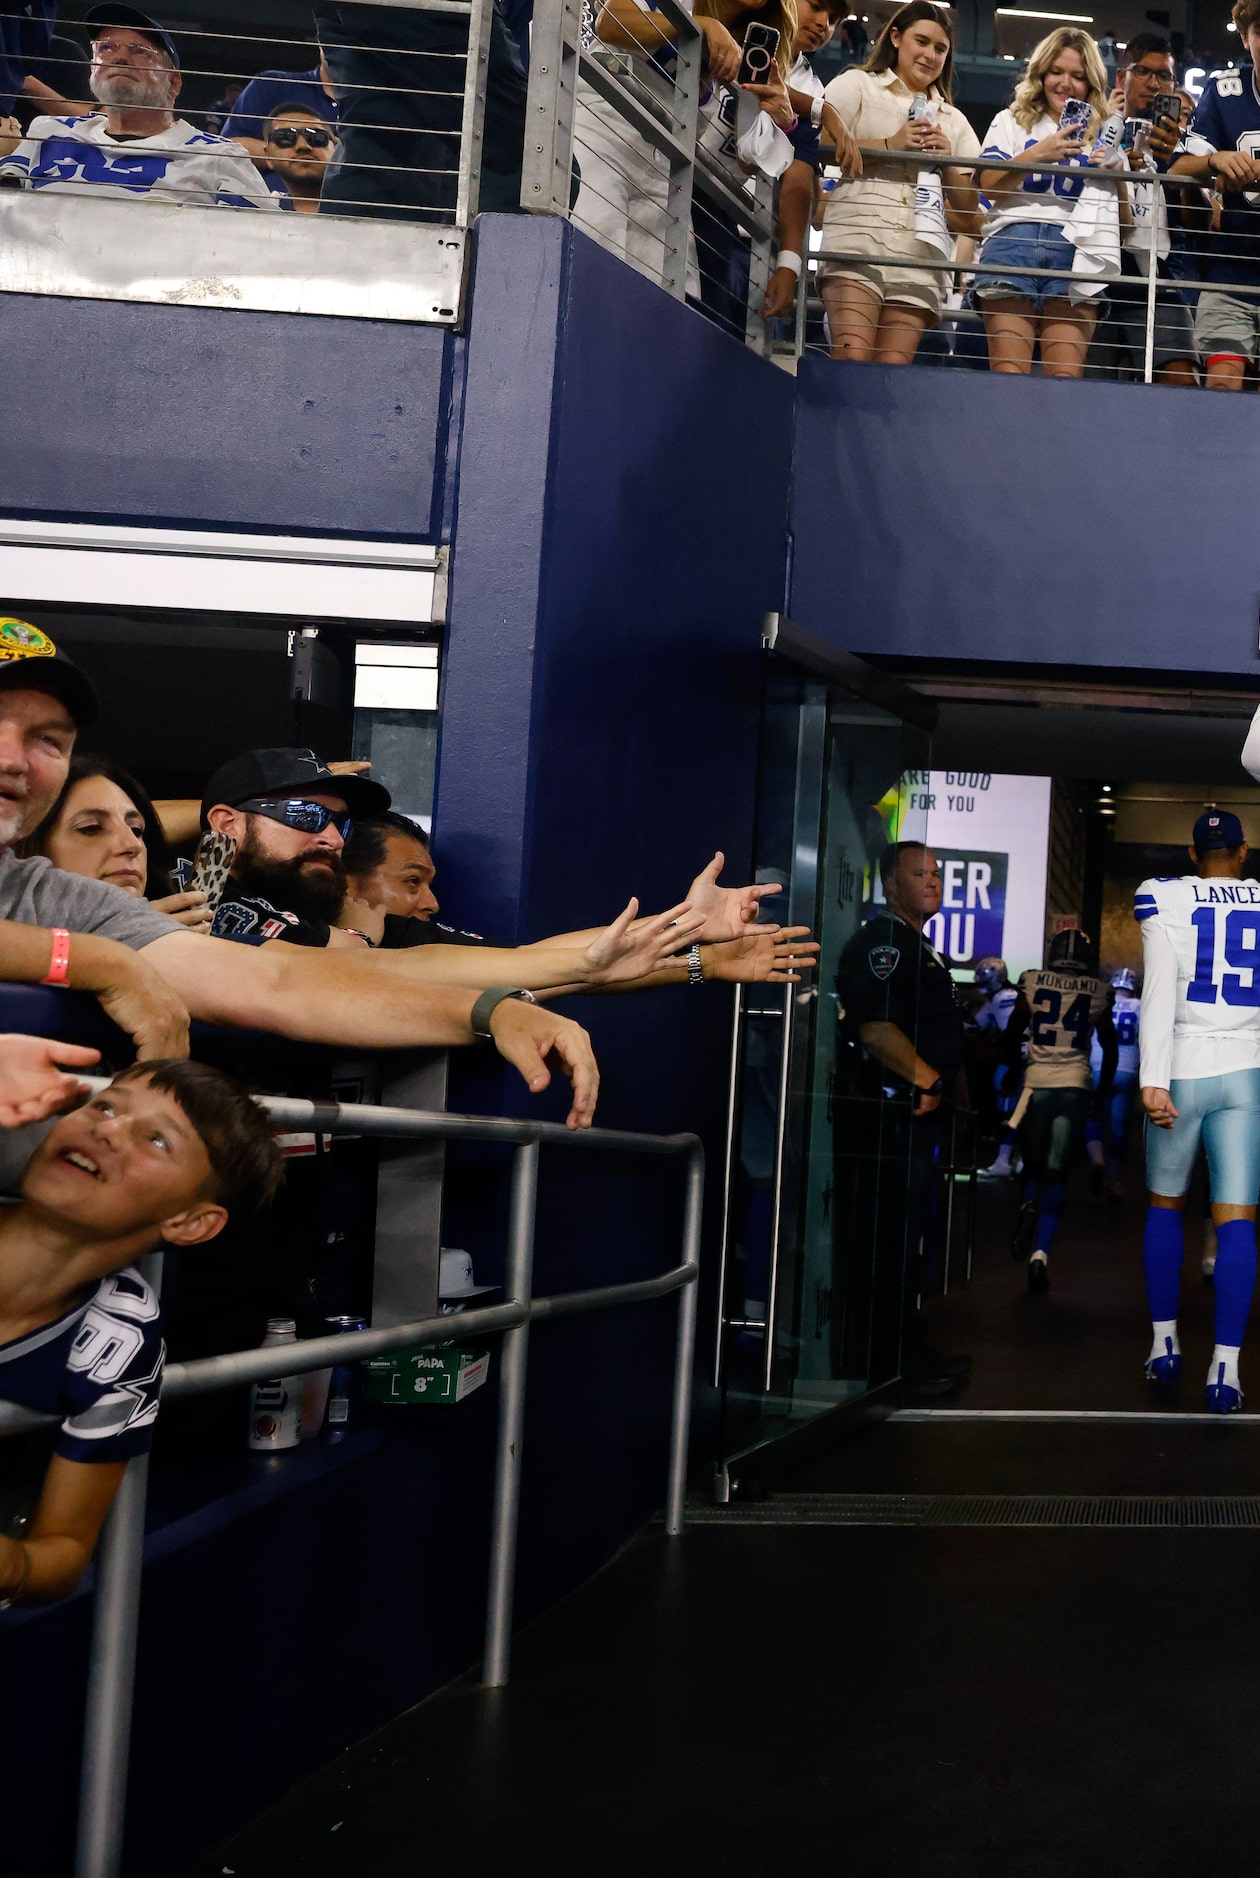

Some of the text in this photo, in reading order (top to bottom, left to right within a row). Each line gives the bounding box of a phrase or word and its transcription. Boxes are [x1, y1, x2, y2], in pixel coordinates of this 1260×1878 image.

[945, 771, 992, 791] GOOD
[910, 793, 975, 812] FOR YOU
[1033, 988, 1092, 1049] 24
[417, 1357, 445, 1369] PAPA
